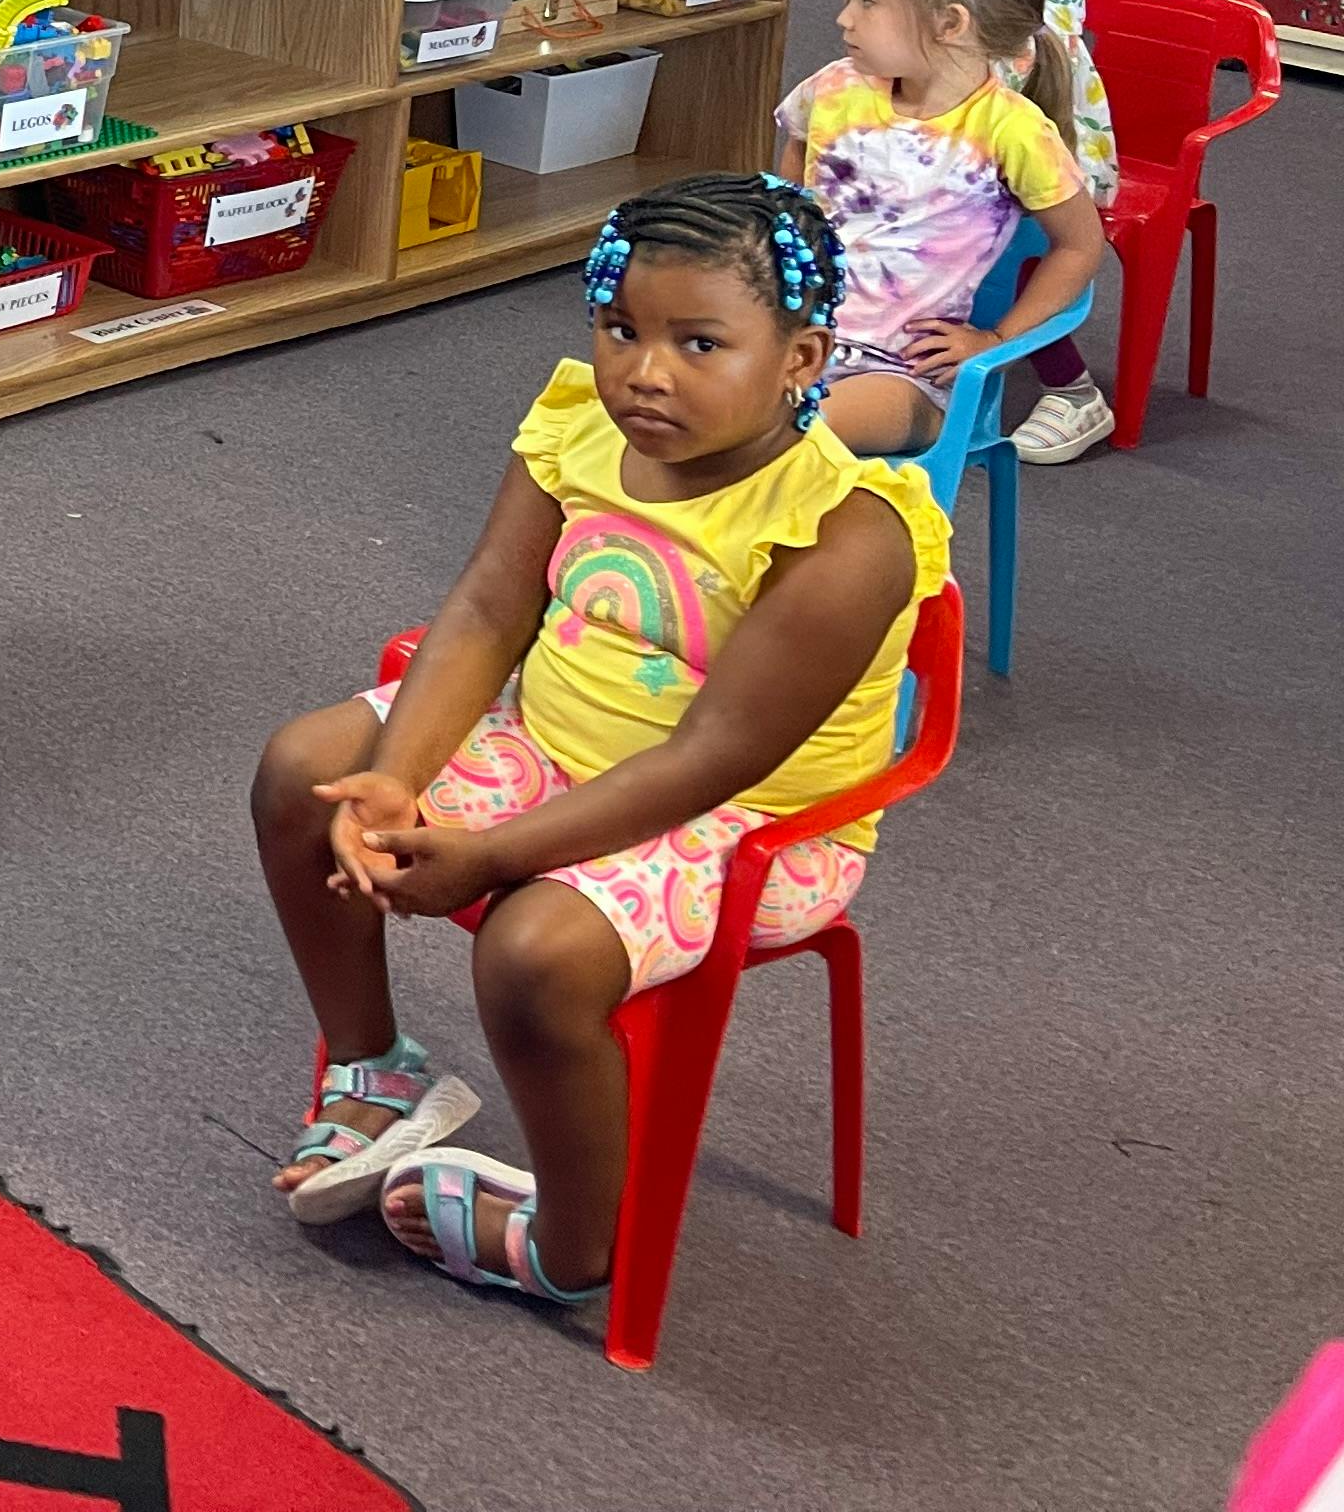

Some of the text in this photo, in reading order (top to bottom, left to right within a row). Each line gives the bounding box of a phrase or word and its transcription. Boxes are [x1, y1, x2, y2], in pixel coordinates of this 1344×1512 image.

[428, 36, 470, 51] MAGNETS
[12, 113, 52, 132] LEGOS
[217, 196, 288, 219] WAFFLE BLOCKS
[9, 291, 50, 311] PIECES
[90, 311, 183, 338] Block Center
